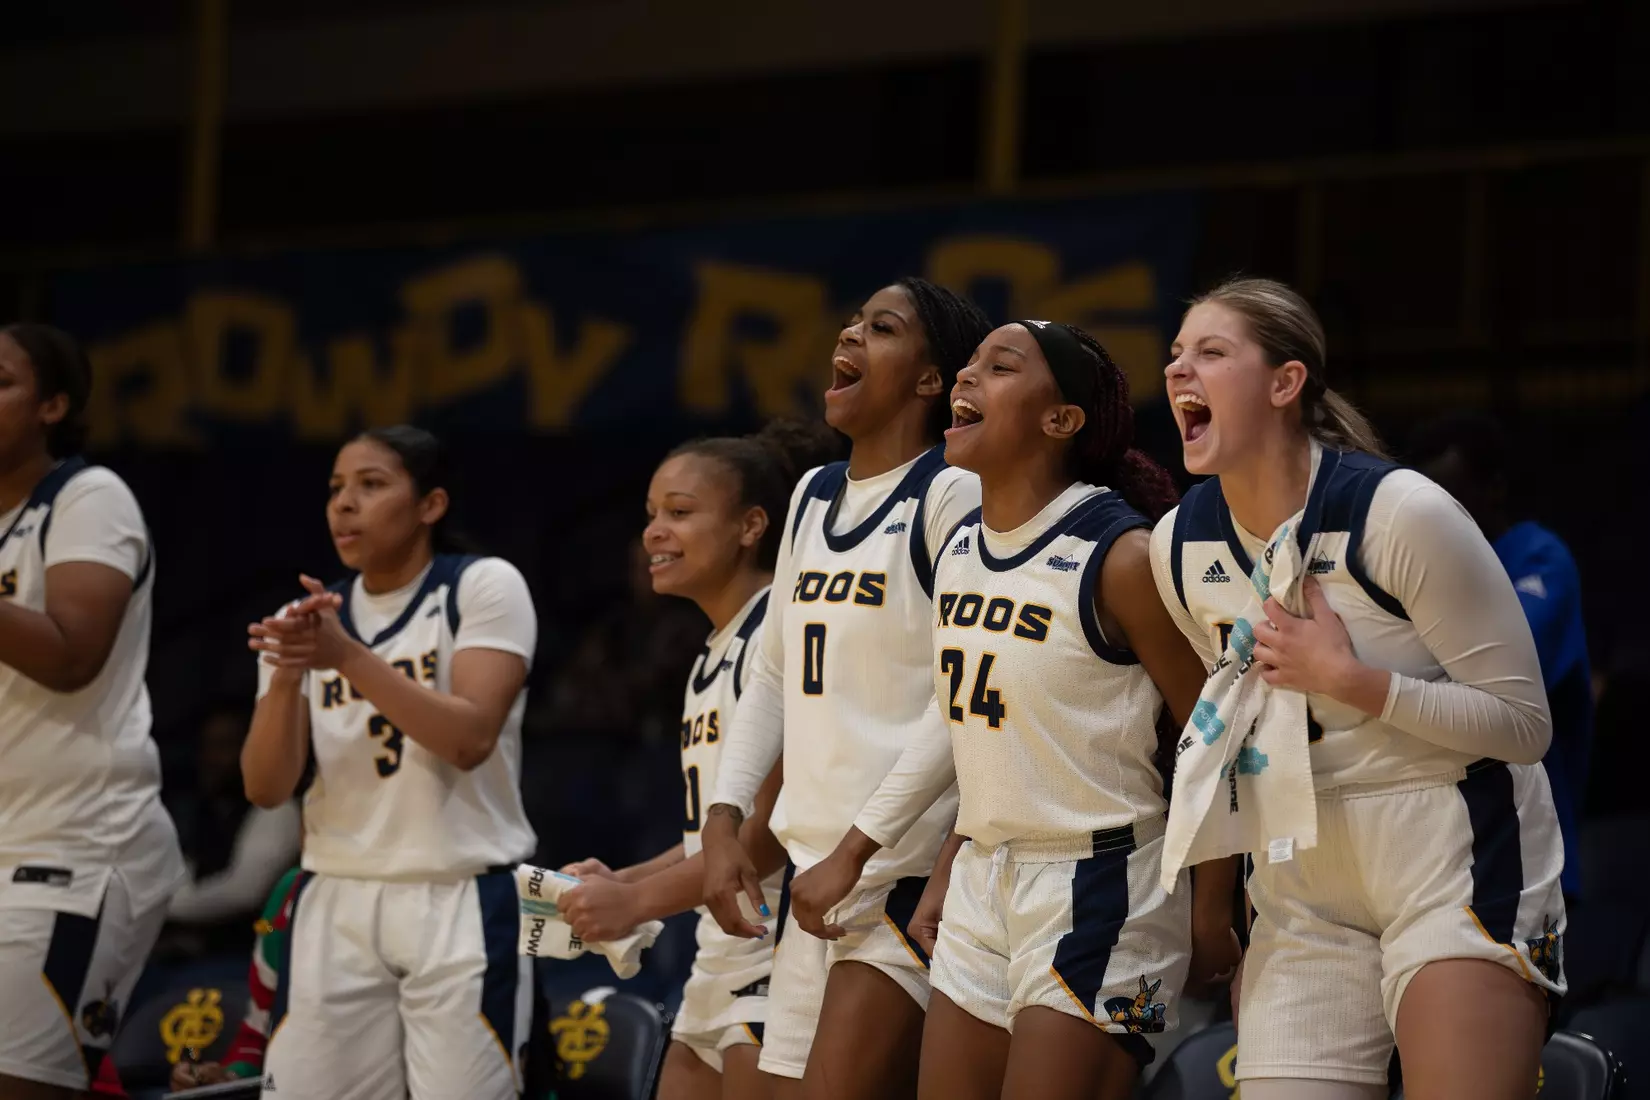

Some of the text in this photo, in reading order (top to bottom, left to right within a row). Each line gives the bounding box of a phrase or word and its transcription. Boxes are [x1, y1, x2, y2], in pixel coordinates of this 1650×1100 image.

[80, 250, 638, 452] ROWDY
[1202, 574, 1231, 583] adidas
[937, 591, 1053, 642] ROOS
[803, 622, 827, 697] 0
[940, 647, 1007, 731] 24
[368, 712, 405, 779] 3
